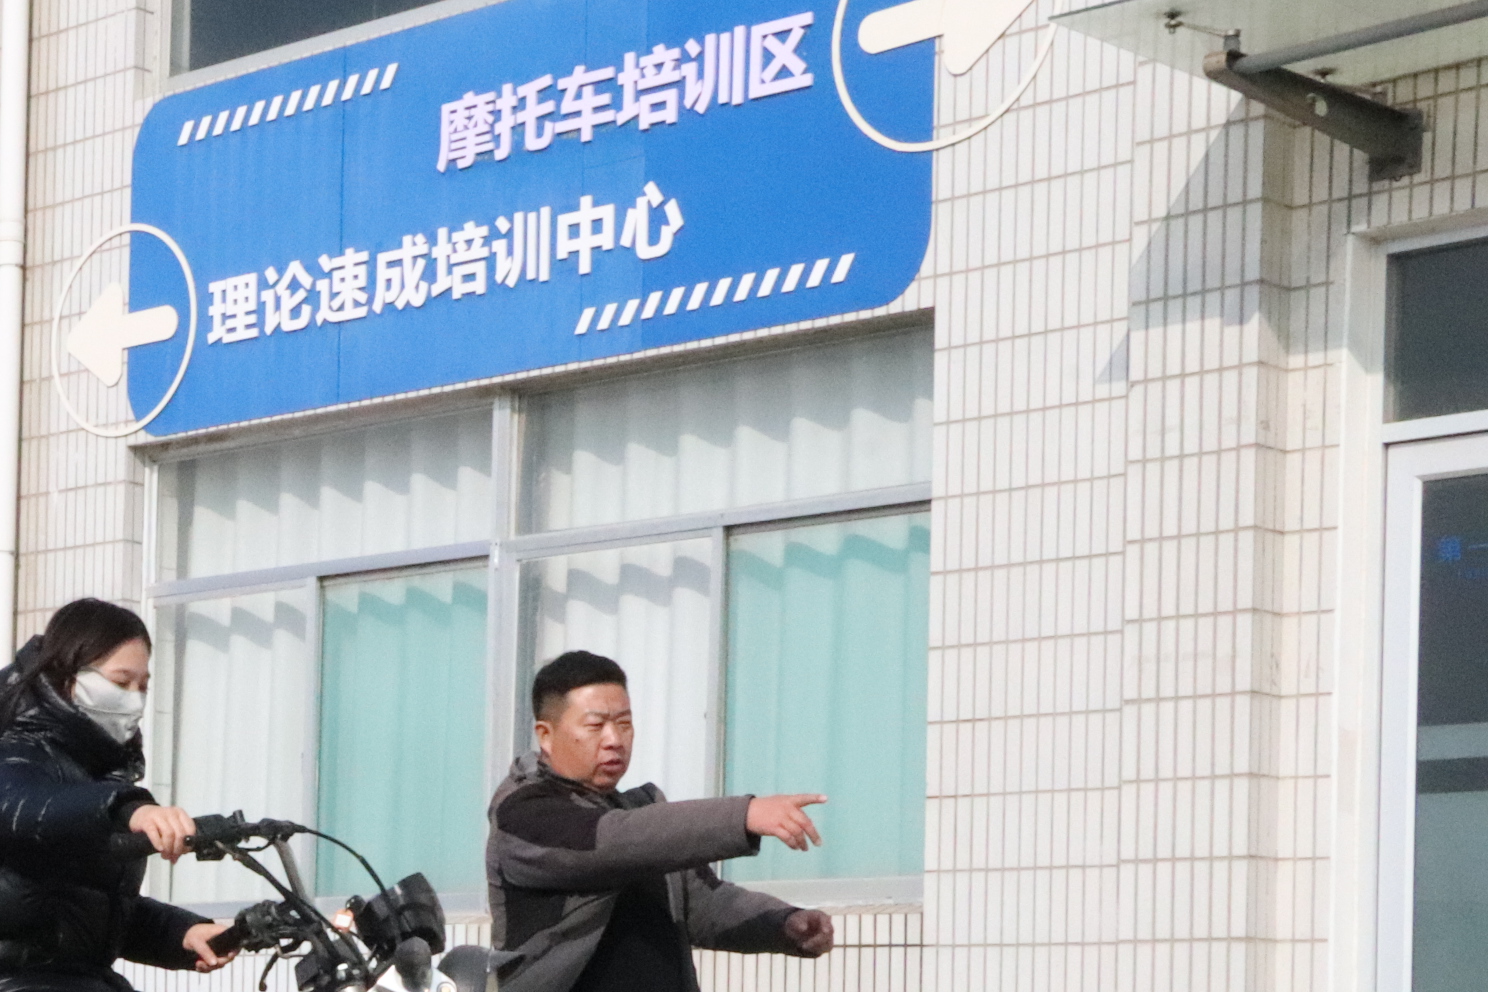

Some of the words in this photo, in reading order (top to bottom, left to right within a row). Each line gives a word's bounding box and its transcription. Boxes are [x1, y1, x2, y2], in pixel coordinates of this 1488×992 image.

[436, 11, 814, 173] 摩托车培训区
[206, 180, 684, 345] 理论速成培训中心
